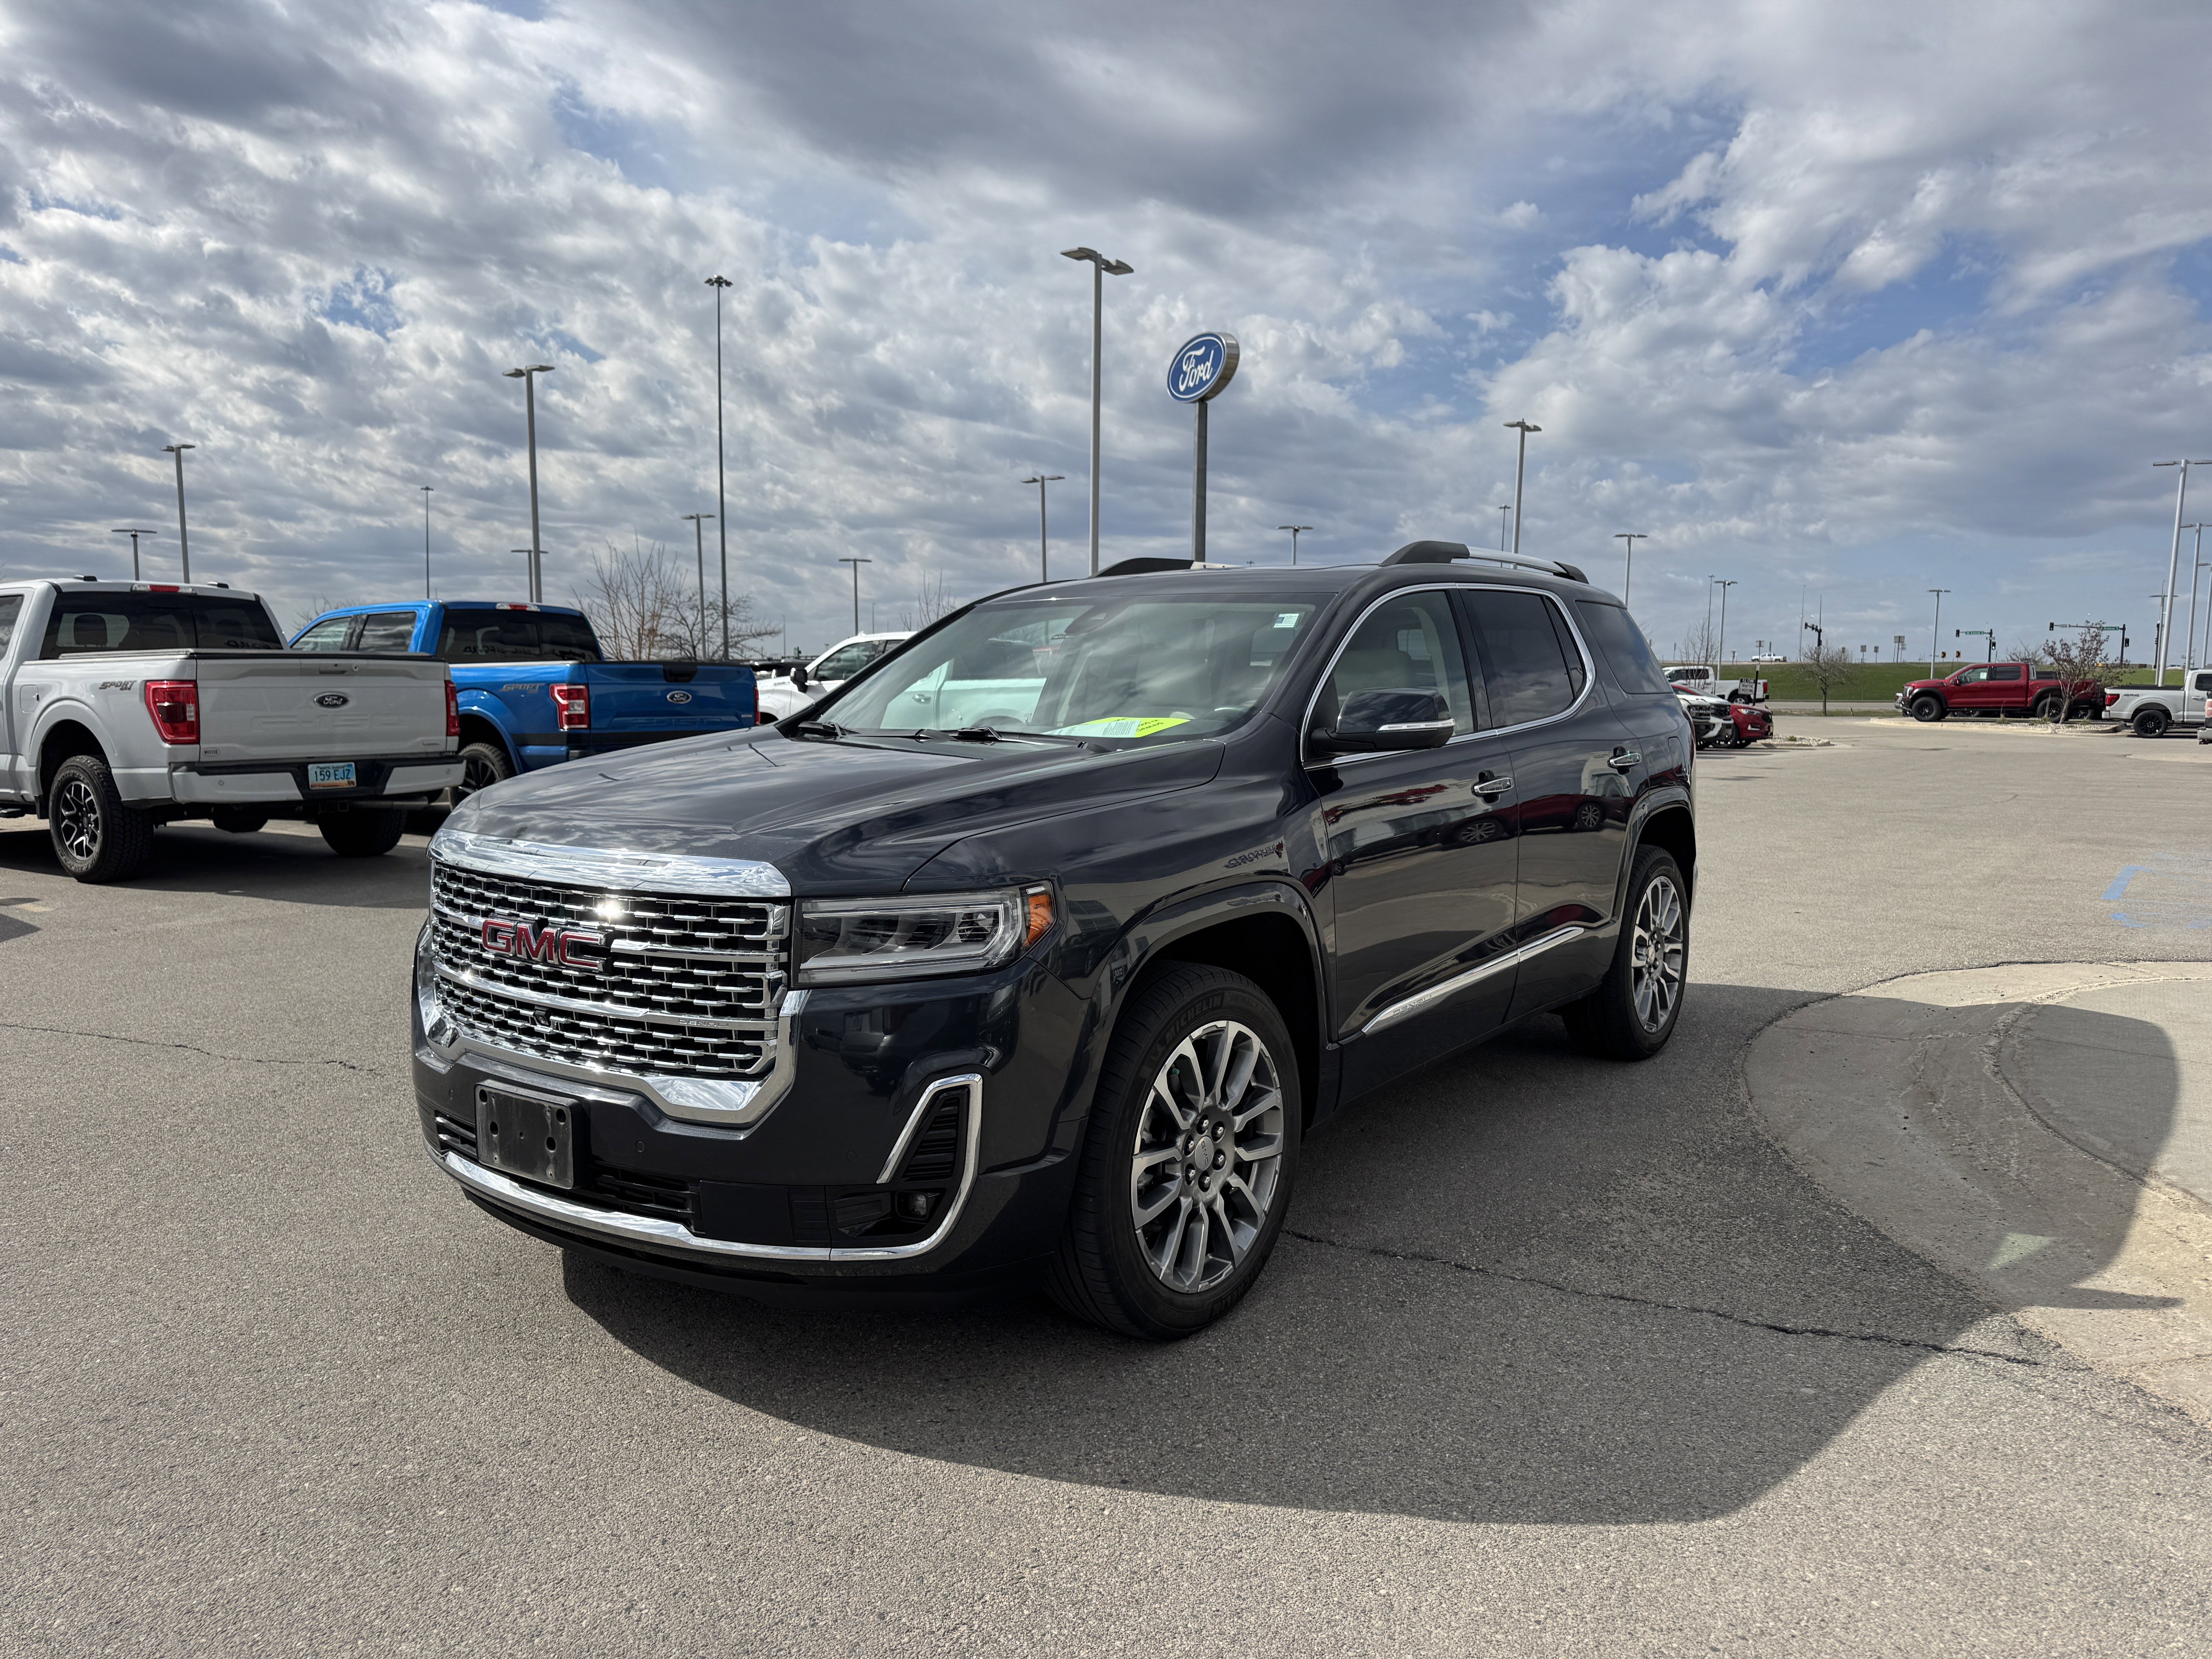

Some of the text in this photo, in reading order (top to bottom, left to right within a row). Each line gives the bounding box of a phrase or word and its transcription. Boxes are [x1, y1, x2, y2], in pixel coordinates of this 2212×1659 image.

[1178, 345, 1214, 392] Ford
[99, 680, 137, 690] SPORT
[498, 683, 544, 692] SPORT
[323, 695, 343, 705] Ford
[314, 768, 351, 781] 159 EJZ
[481, 919, 606, 972] GMC
[678, 1019, 730, 1028] DENALI
[1165, 994, 1223, 1045] MICHELIN
